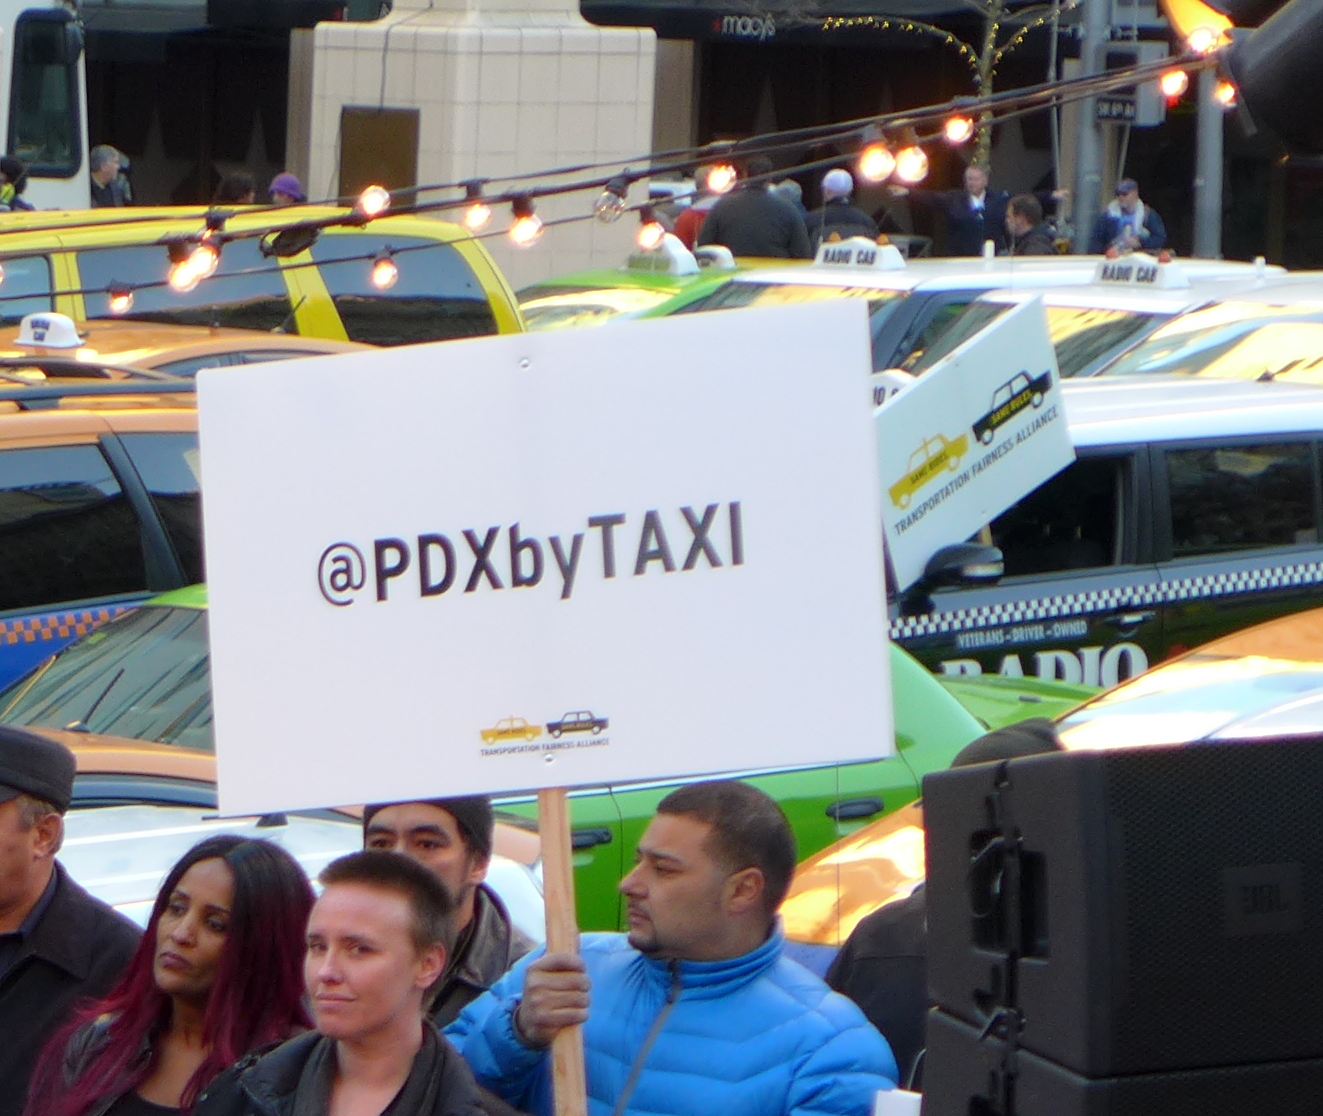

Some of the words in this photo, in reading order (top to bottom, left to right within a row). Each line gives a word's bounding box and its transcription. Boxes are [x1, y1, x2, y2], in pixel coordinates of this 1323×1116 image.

[893, 470, 971, 537] TRANSPORTATION
[971, 438, 1016, 477] FAIRNESS
[1014, 405, 1059, 446] ALLIANCE
[316, 499, 746, 608] @PDXbyTAXI
